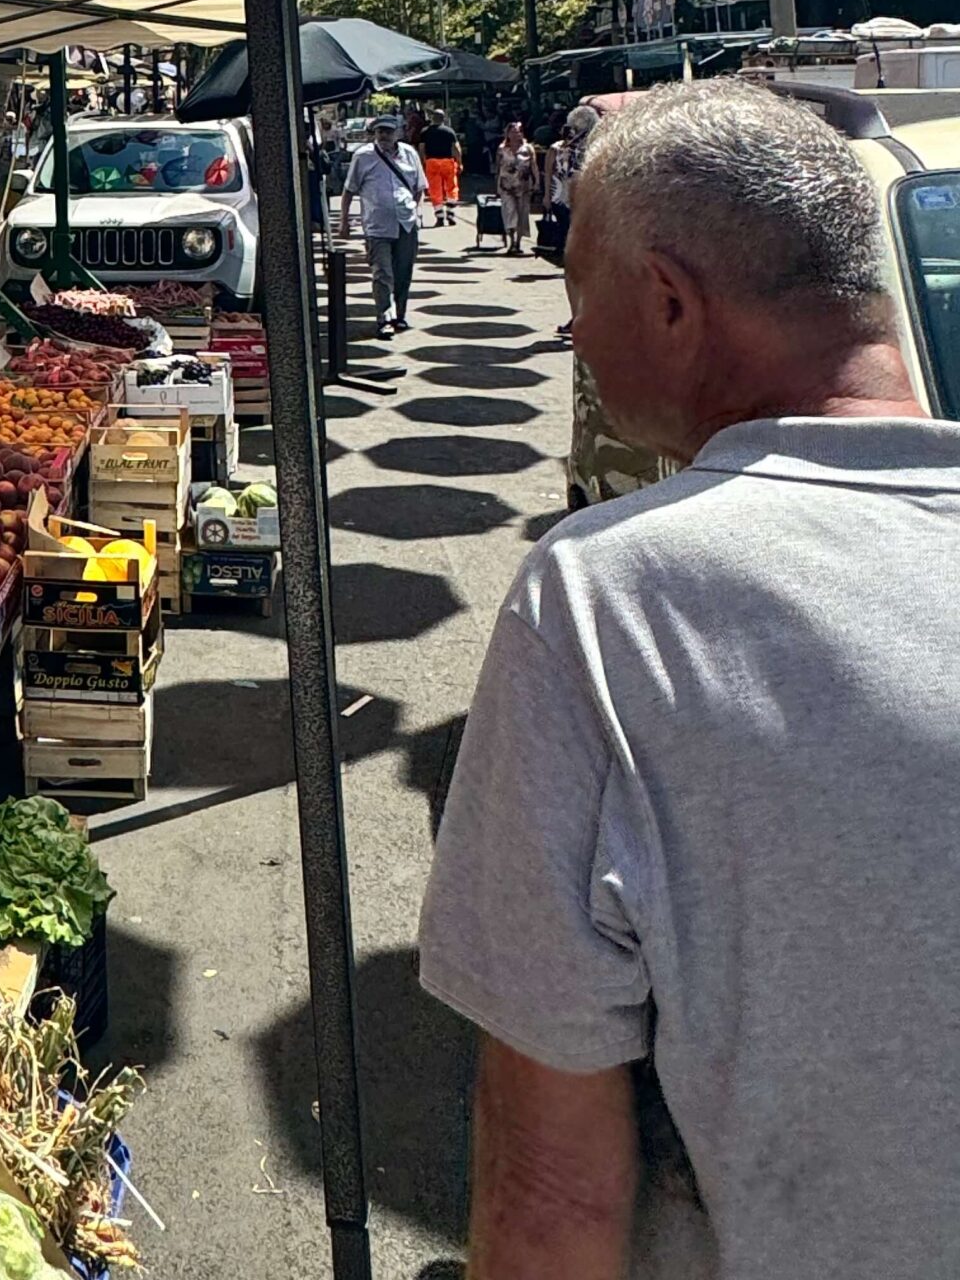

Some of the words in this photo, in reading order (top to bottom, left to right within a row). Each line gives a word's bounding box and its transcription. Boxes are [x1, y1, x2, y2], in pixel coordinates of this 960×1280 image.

[206, 564, 264, 580] ALESCI
[42, 606, 121, 626] SICILIA
[33, 672, 83, 690] Doppio
[86, 675, 129, 691] Gusto
